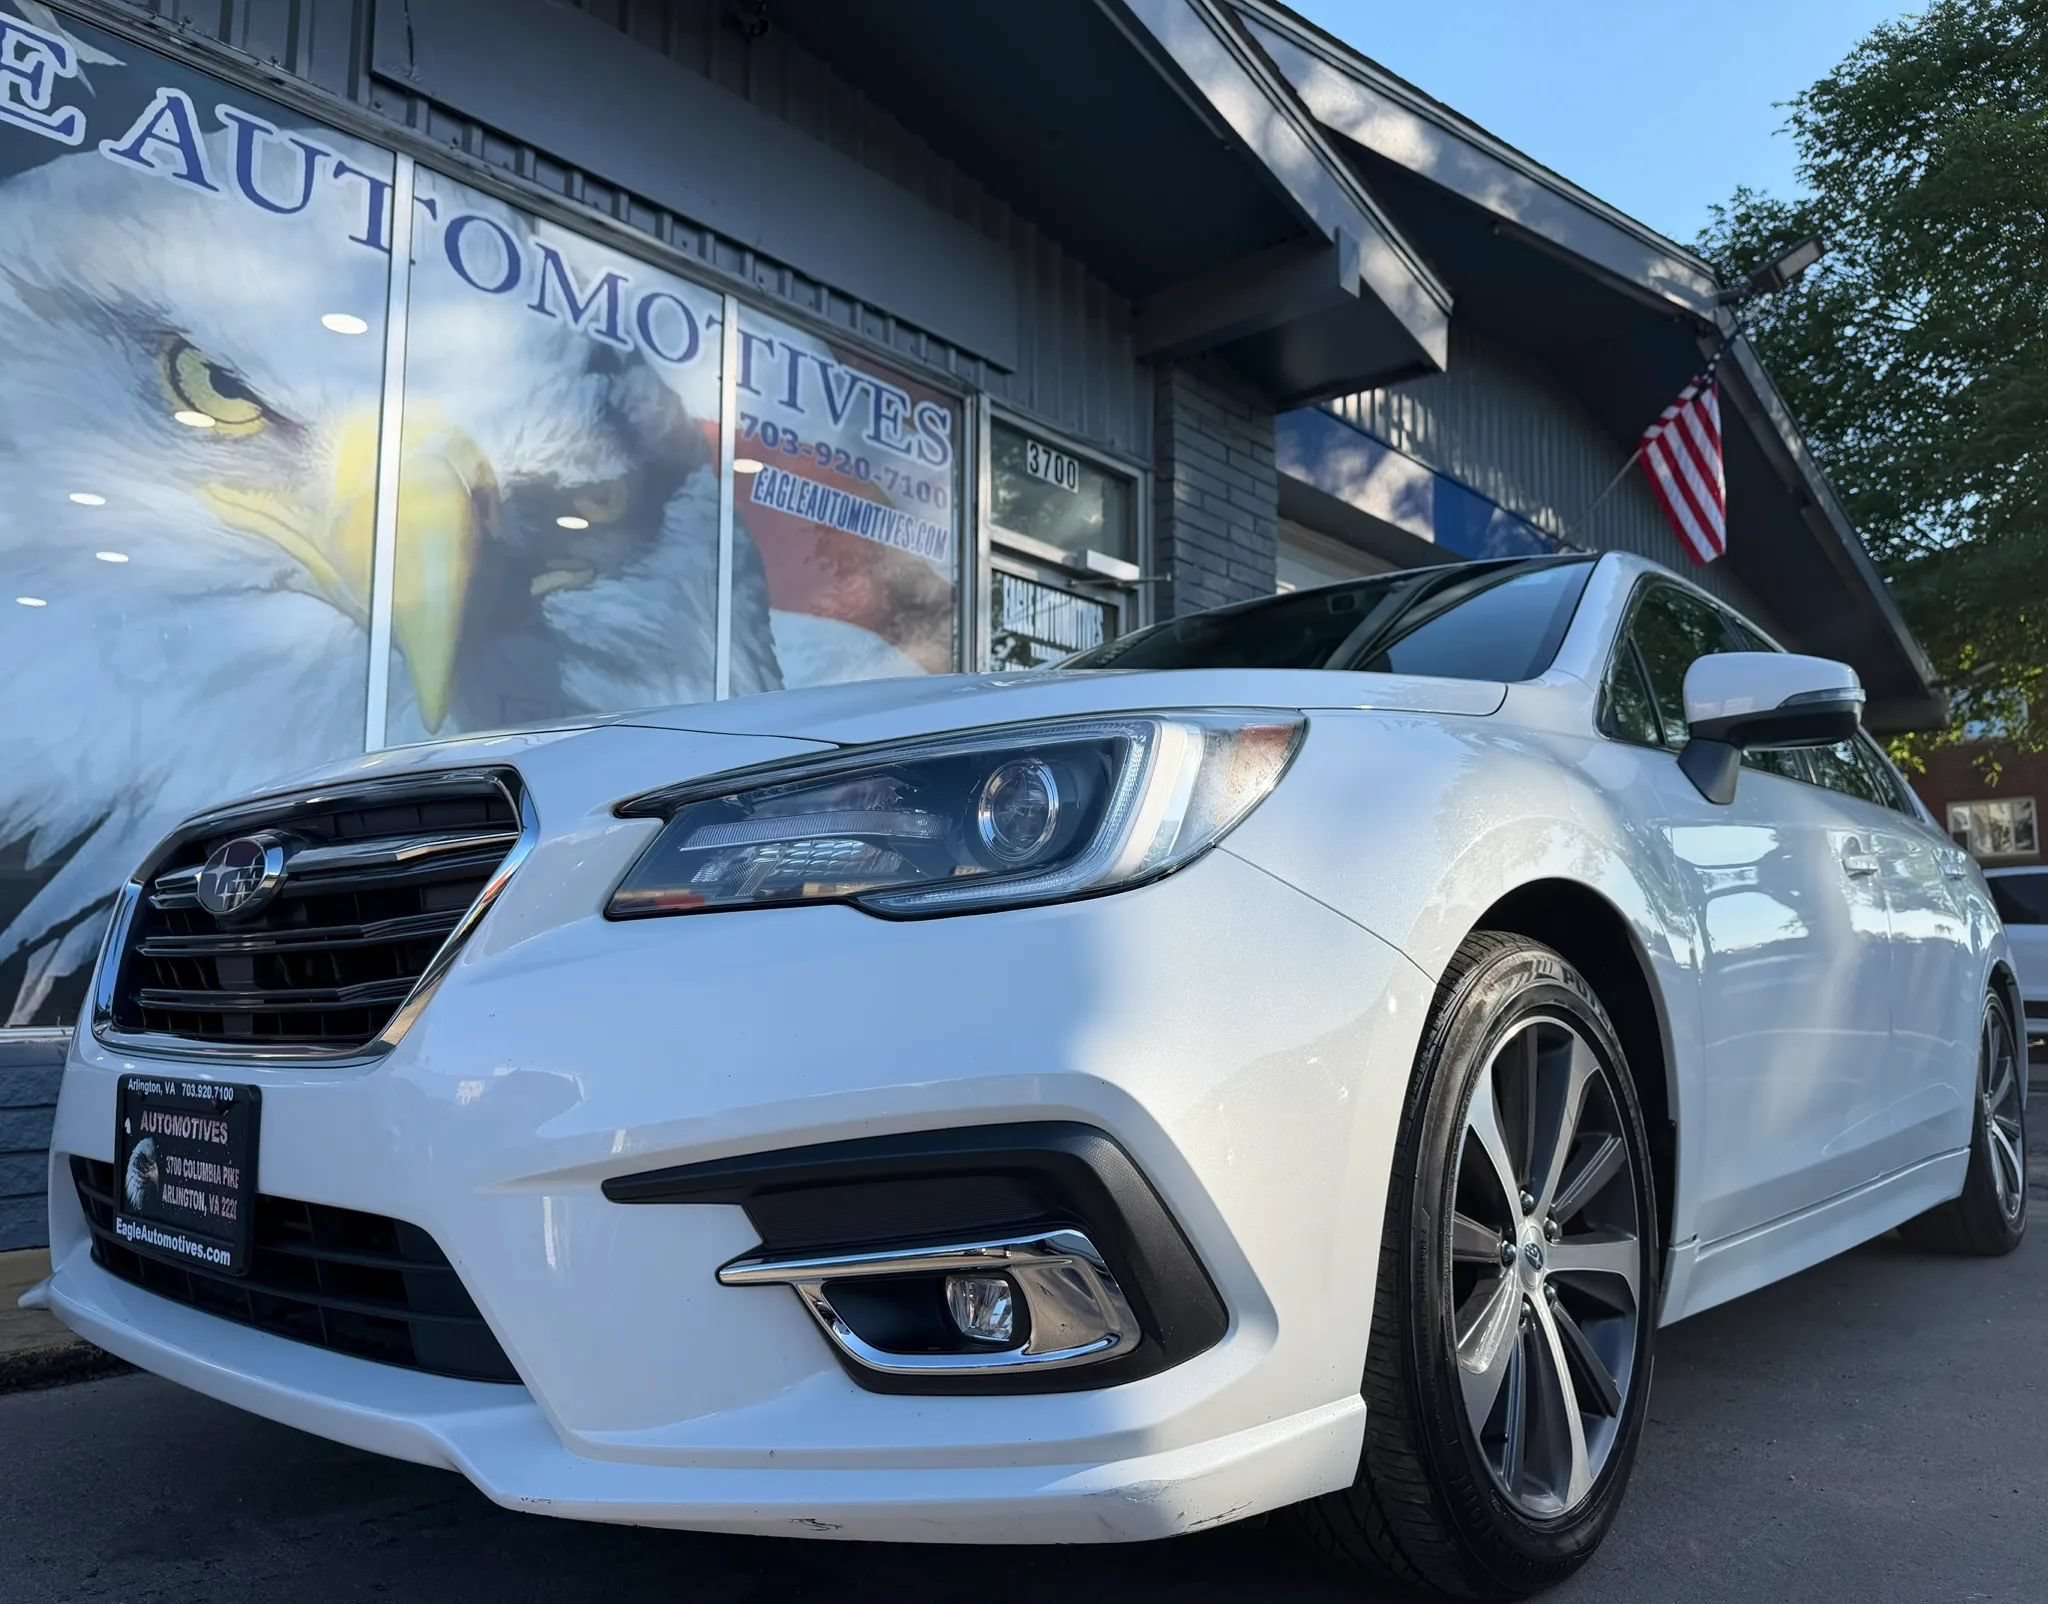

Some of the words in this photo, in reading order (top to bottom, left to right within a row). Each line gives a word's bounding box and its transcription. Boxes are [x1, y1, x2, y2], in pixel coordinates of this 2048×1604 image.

[107, 93, 950, 468] AUTOMOTIVES
[740, 412, 948, 510] 703-920-7100
[1029, 443, 1077, 490] 3700
[752, 466, 949, 562] EAGLEAUTOMOTIVES.COM
[127, 1078, 163, 1097] Arlington,
[164, 1081, 176, 1096] VA
[181, 1083, 234, 1101] 703.920.7100
[140, 1110, 228, 1145] AUTOMOTIVES
[166, 1155, 182, 1176] 3700
[183, 1158, 222, 1185] COLUMBIA
[222, 1166, 241, 1190] PIKE
[162, 1183, 207, 1217] ARLINGTON,
[208, 1193, 220, 1215] VA
[116, 1217, 231, 1267] EagleAutomotives.com
